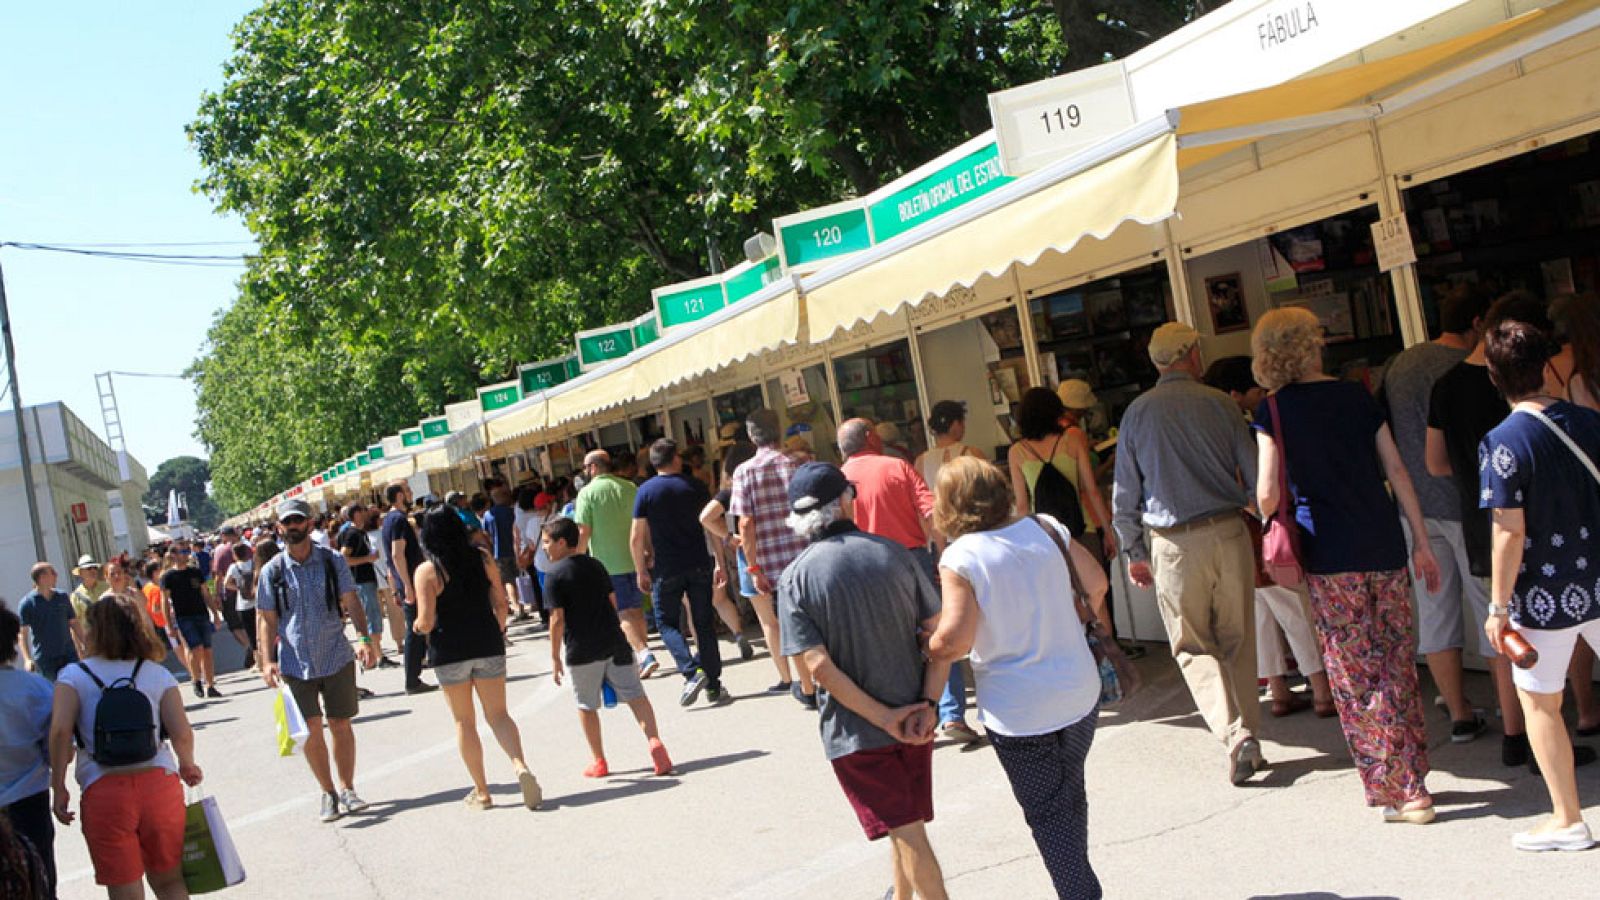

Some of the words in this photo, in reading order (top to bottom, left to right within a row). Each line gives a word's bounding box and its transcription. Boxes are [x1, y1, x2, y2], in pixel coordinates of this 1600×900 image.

[1258, 2, 1318, 50] FÁBULA
[1040, 104, 1081, 134] 119
[898, 189, 931, 222] BOLETÍN
[957, 169, 975, 194] DEL
[813, 226, 842, 248] 120
[684, 297, 705, 314] 121
[598, 339, 615, 352] 122
[536, 371, 553, 383] 123
[494, 391, 508, 403] 124
